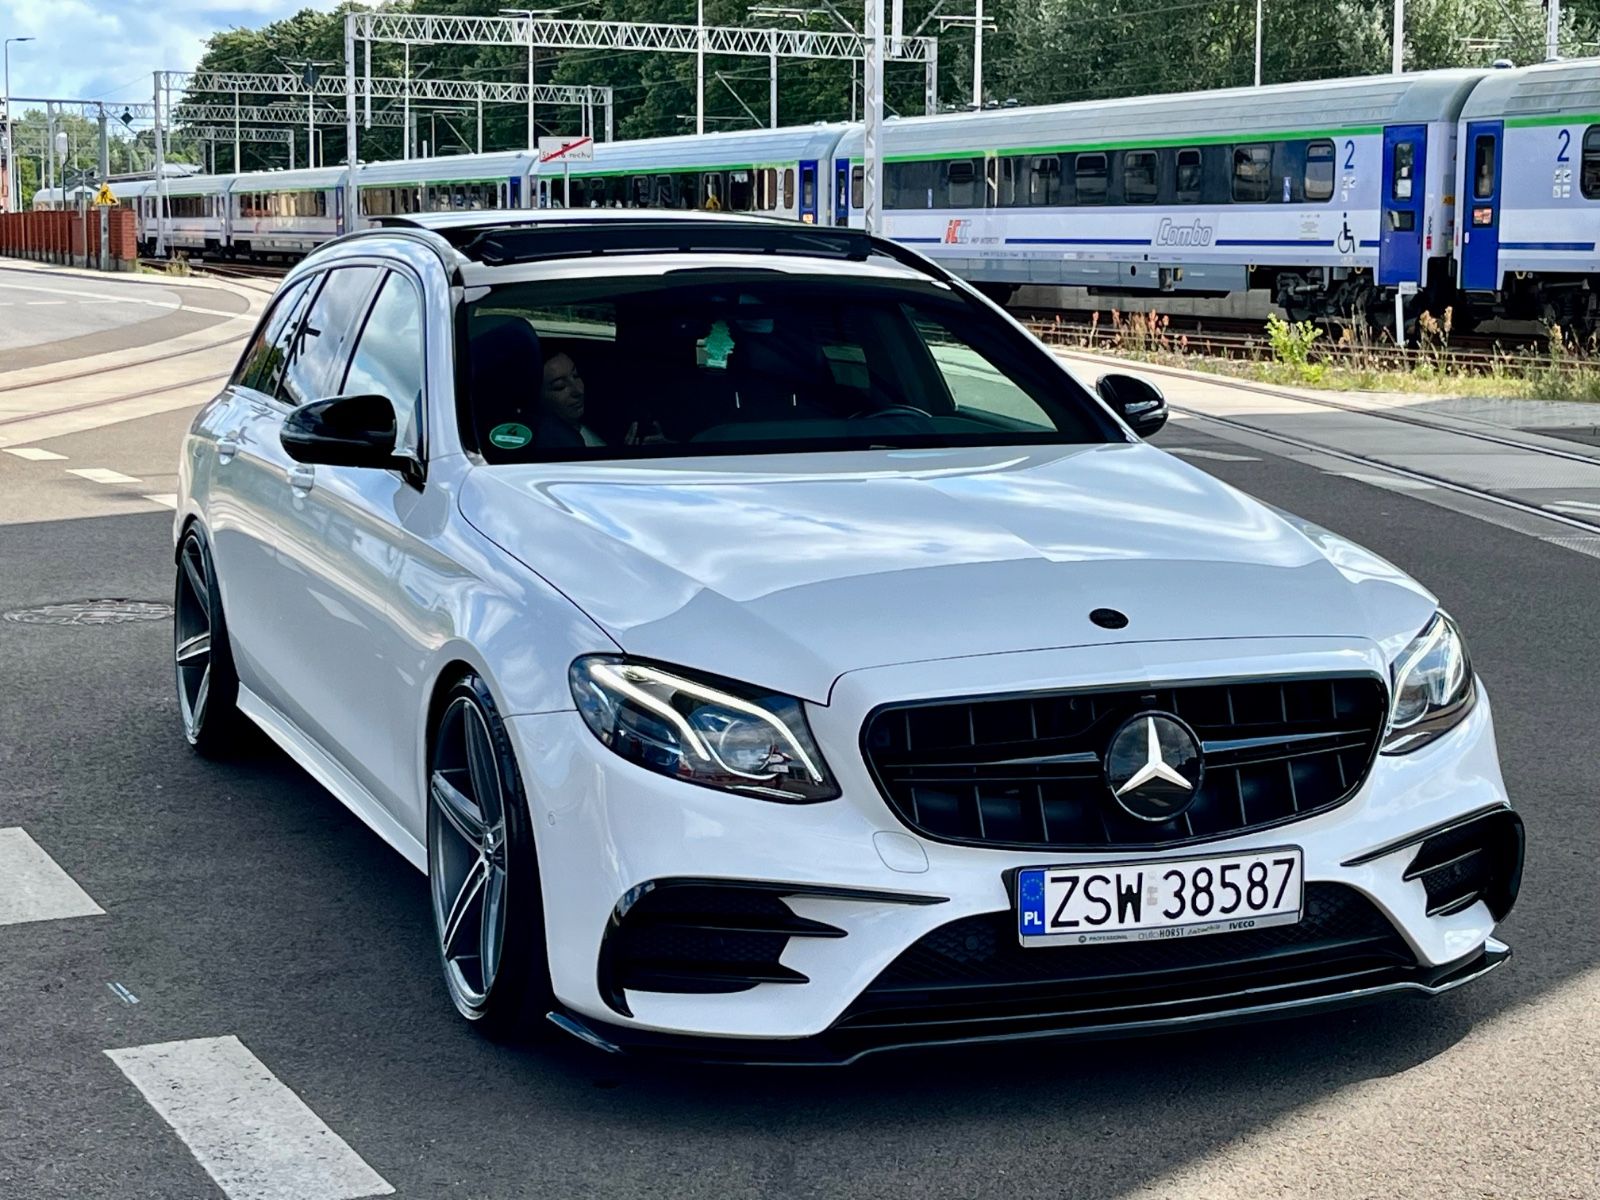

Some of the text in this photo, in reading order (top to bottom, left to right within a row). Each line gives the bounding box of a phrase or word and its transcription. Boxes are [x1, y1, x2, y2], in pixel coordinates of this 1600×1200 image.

[1344, 139, 1355, 170] 2
[1557, 129, 1570, 162] 2
[1156, 218, 1213, 247] Combo
[1050, 857, 1295, 928] ZSW 38587
[1024, 912, 1042, 926] PL
[1229, 920, 1255, 930] IVECO
